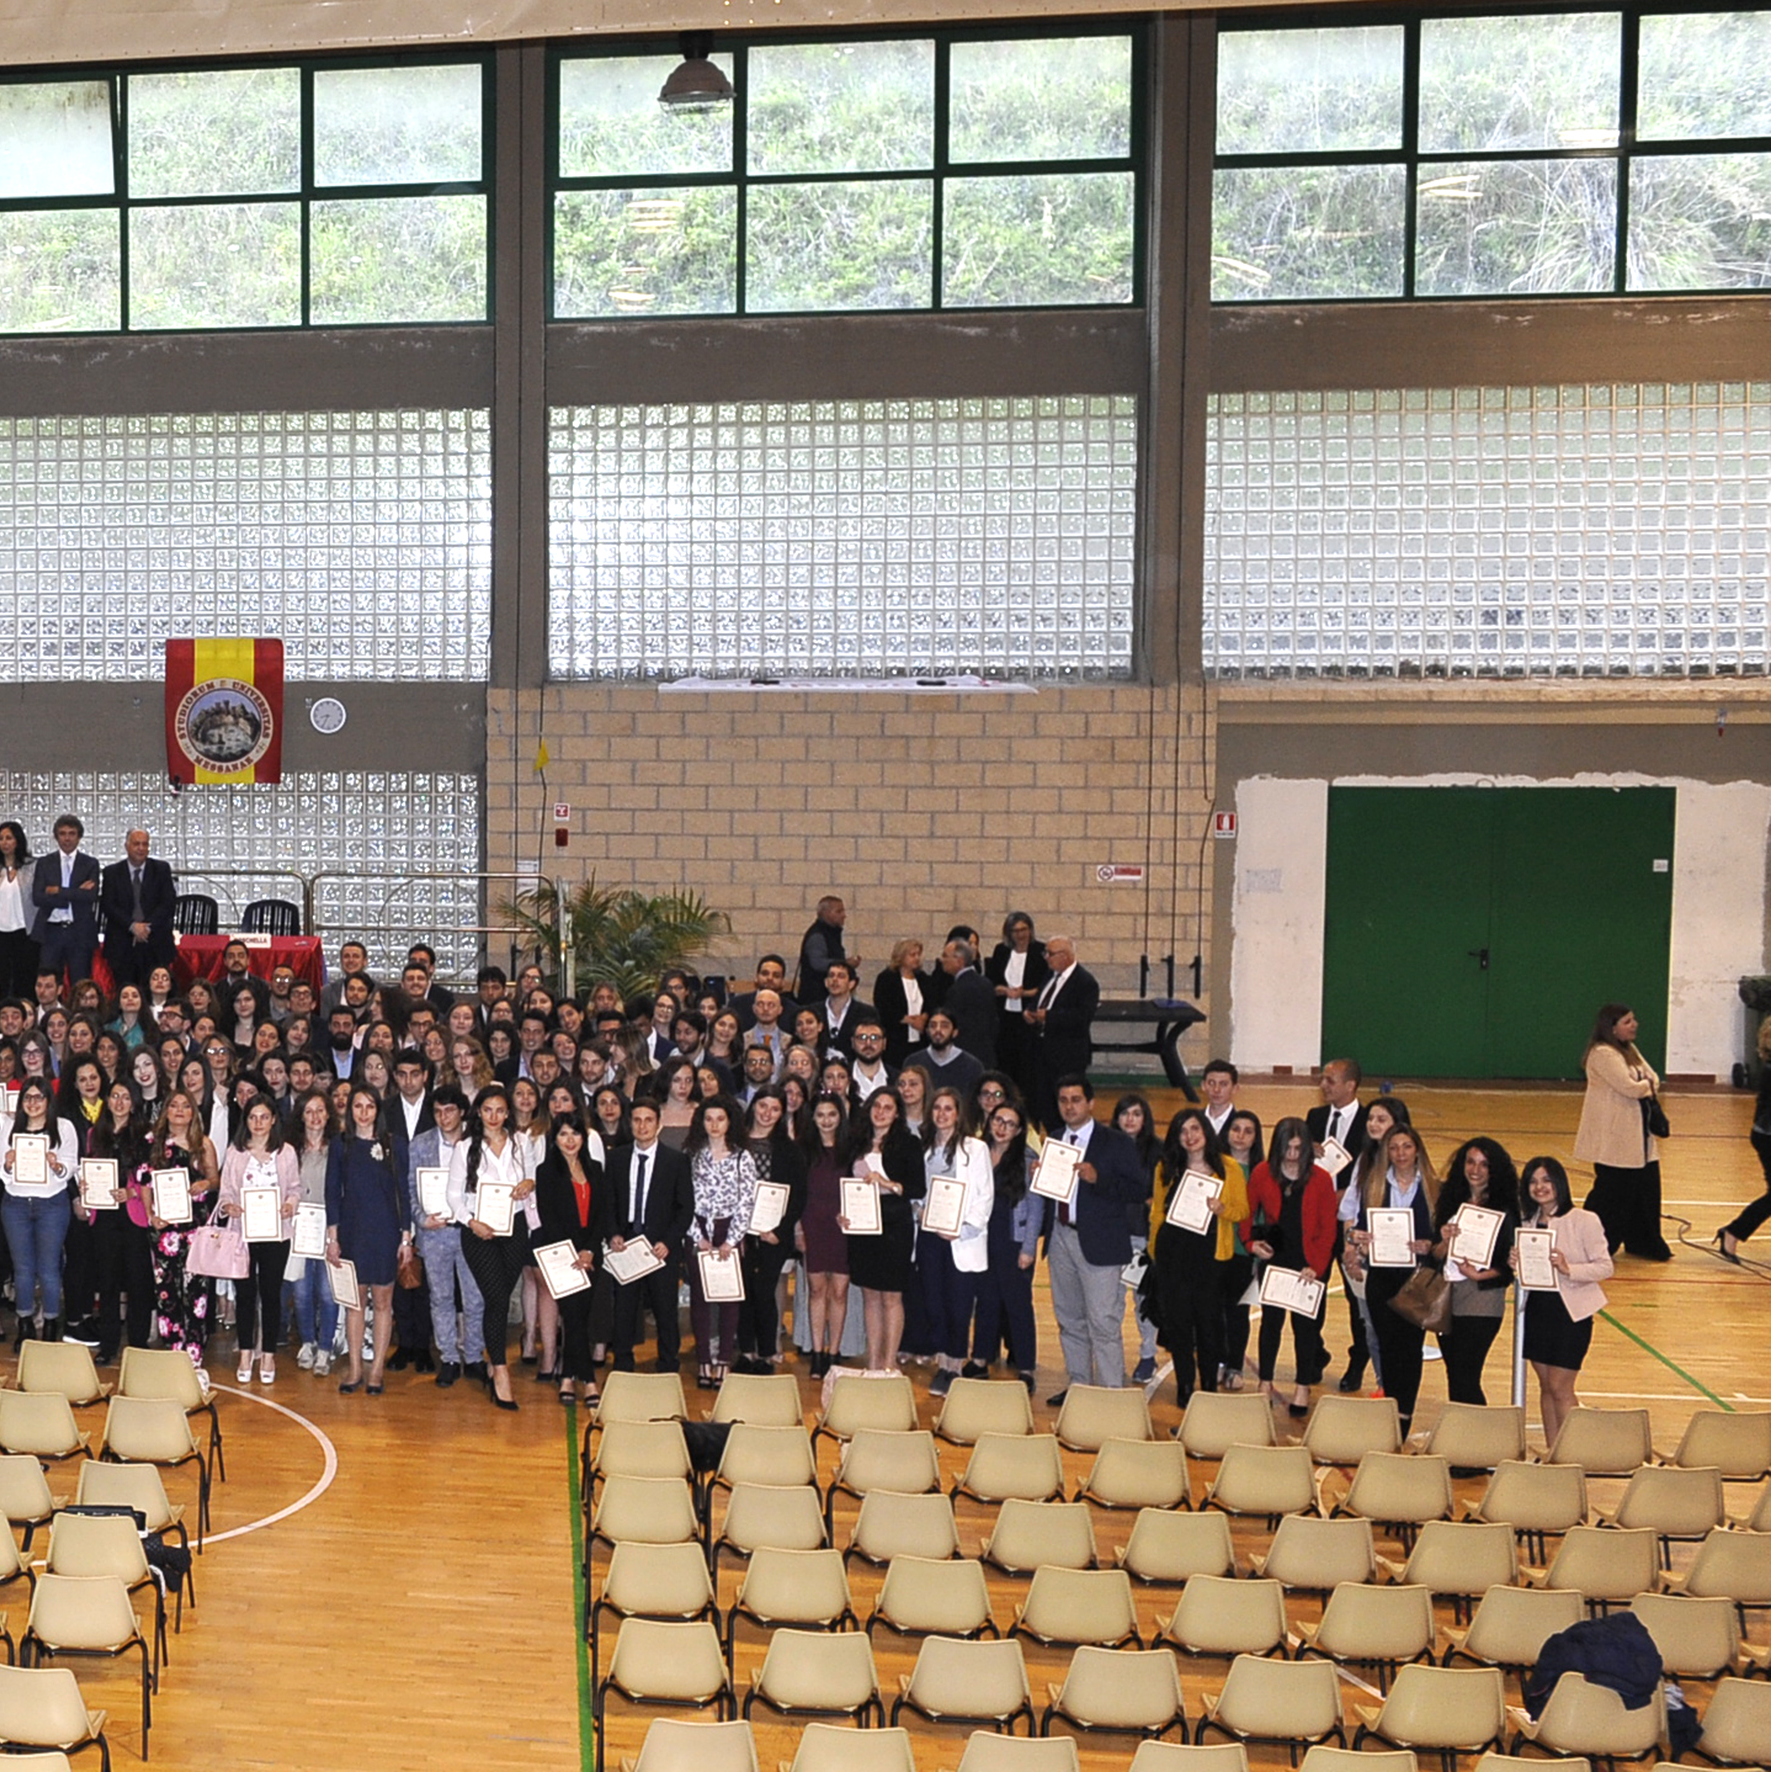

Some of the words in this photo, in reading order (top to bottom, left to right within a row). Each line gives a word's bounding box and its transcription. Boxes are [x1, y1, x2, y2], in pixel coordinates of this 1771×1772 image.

[177, 681, 215, 740] STUDIORUM
[232, 681, 271, 739] UNIVERSITAS
[194, 755, 253, 773] MESSANAE
